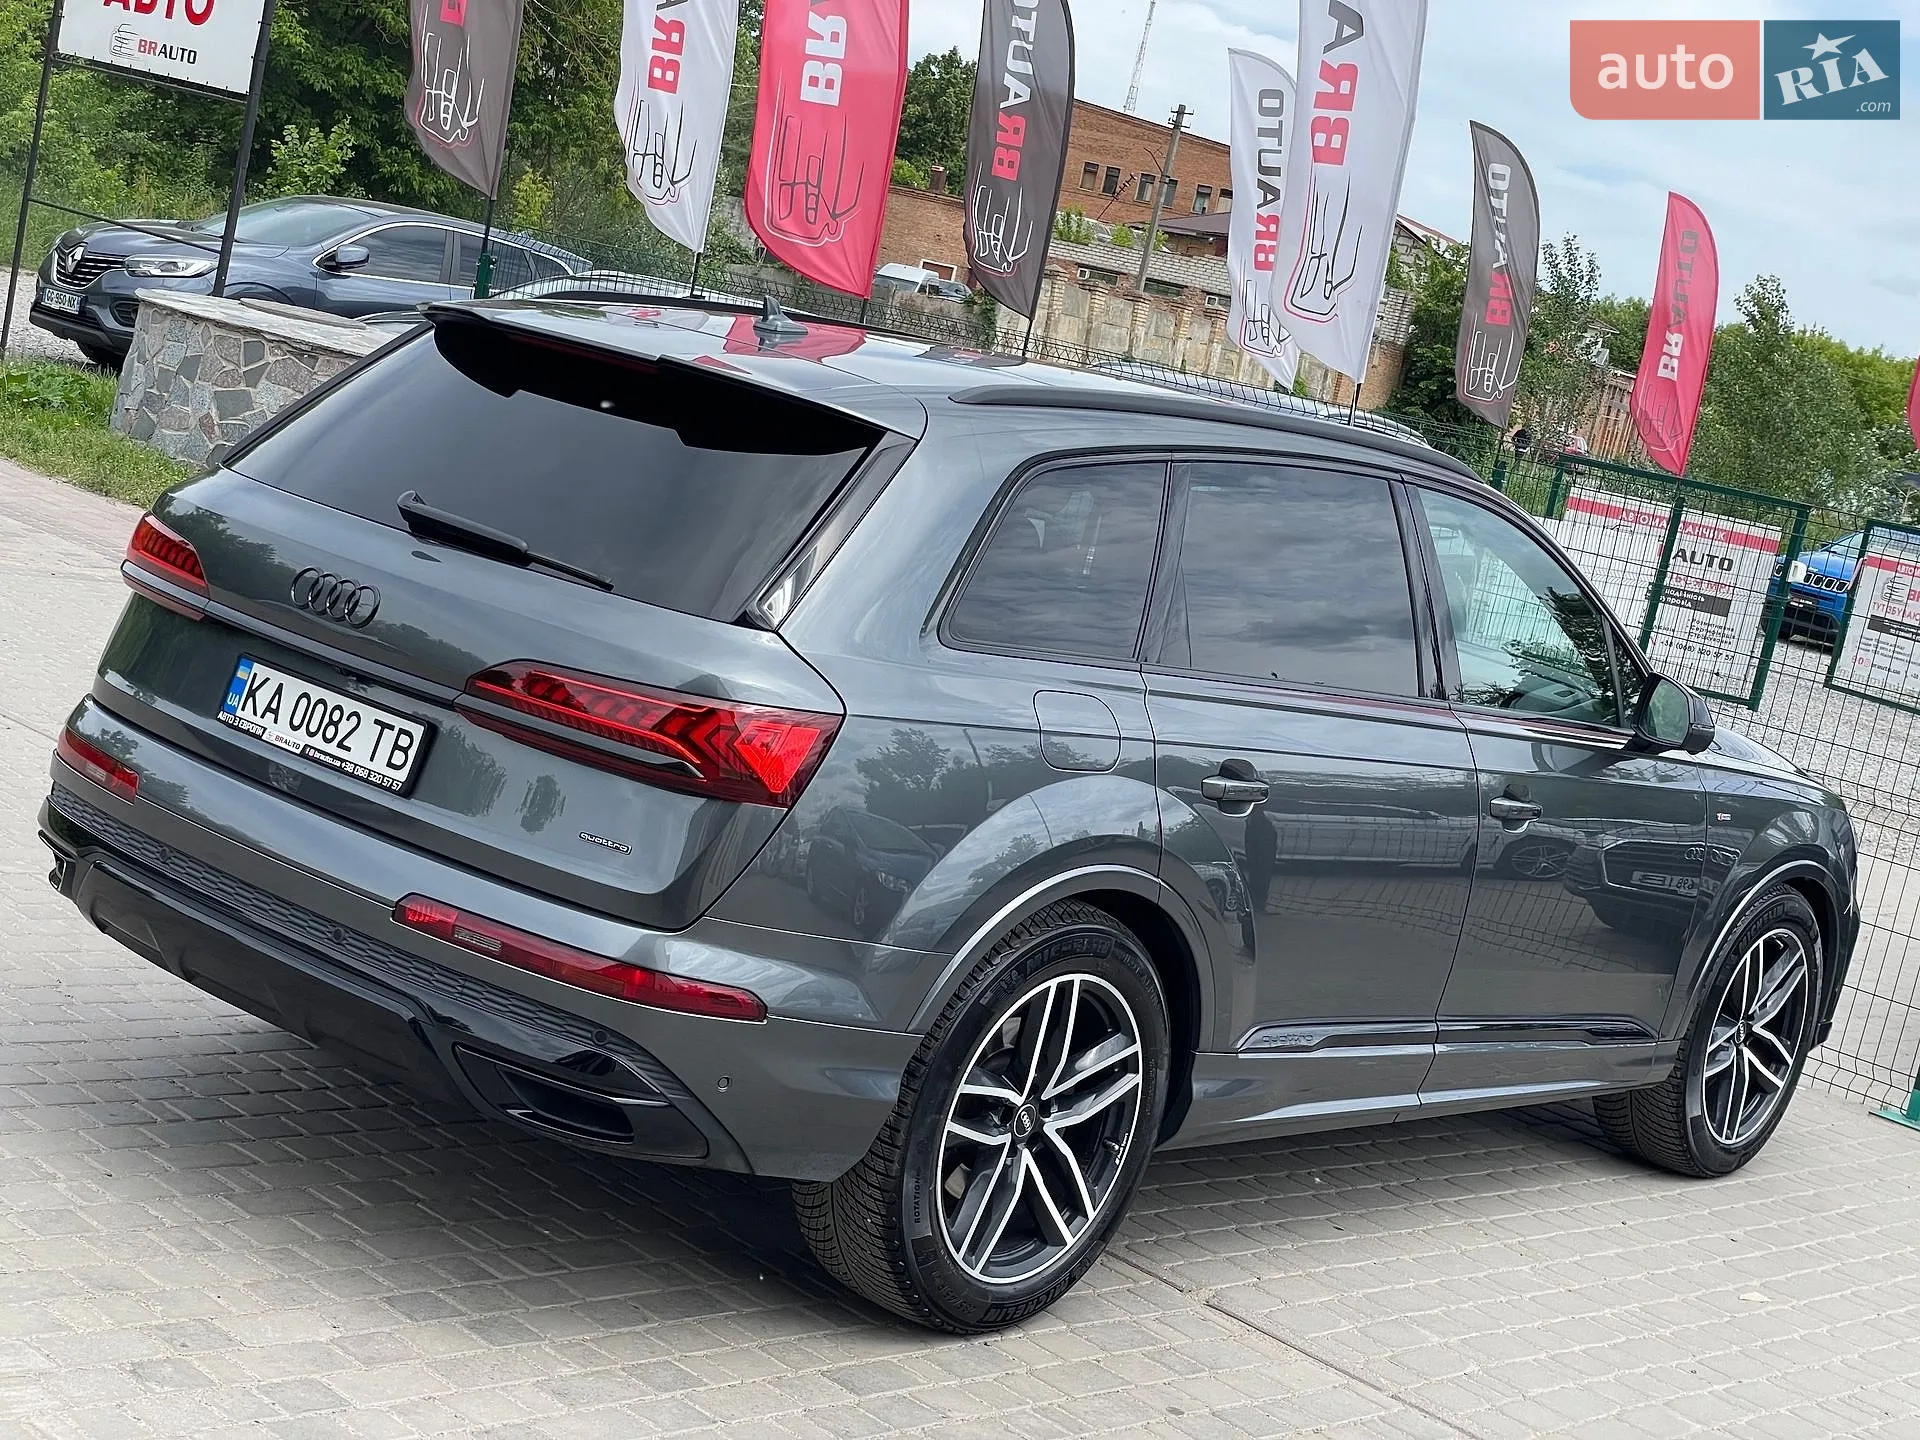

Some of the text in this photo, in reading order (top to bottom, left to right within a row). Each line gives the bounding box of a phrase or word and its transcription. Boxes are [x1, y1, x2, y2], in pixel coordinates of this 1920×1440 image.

[137, 38, 198, 65] BRAUTO
[1618, 510, 1727, 542] АВТОМАДАНЧИК
[227, 692, 240, 709] UA
[217, 711, 234, 724] АВТО
[240, 672, 415, 771] KA 0082 TB
[274, 734, 301, 750] BRAUTO
[341, 761, 354, 773] +38
[354, 766, 369, 779] 068
[368, 770, 383, 783] 320
[382, 775, 392, 787] 57
[392, 779, 403, 791] 57
[580, 832, 629, 853] quattro
[1261, 1033, 1314, 1046] quattro
[913, 1177, 921, 1224] ROTATION
[979, 1272, 1077, 1322] MICHELIN
